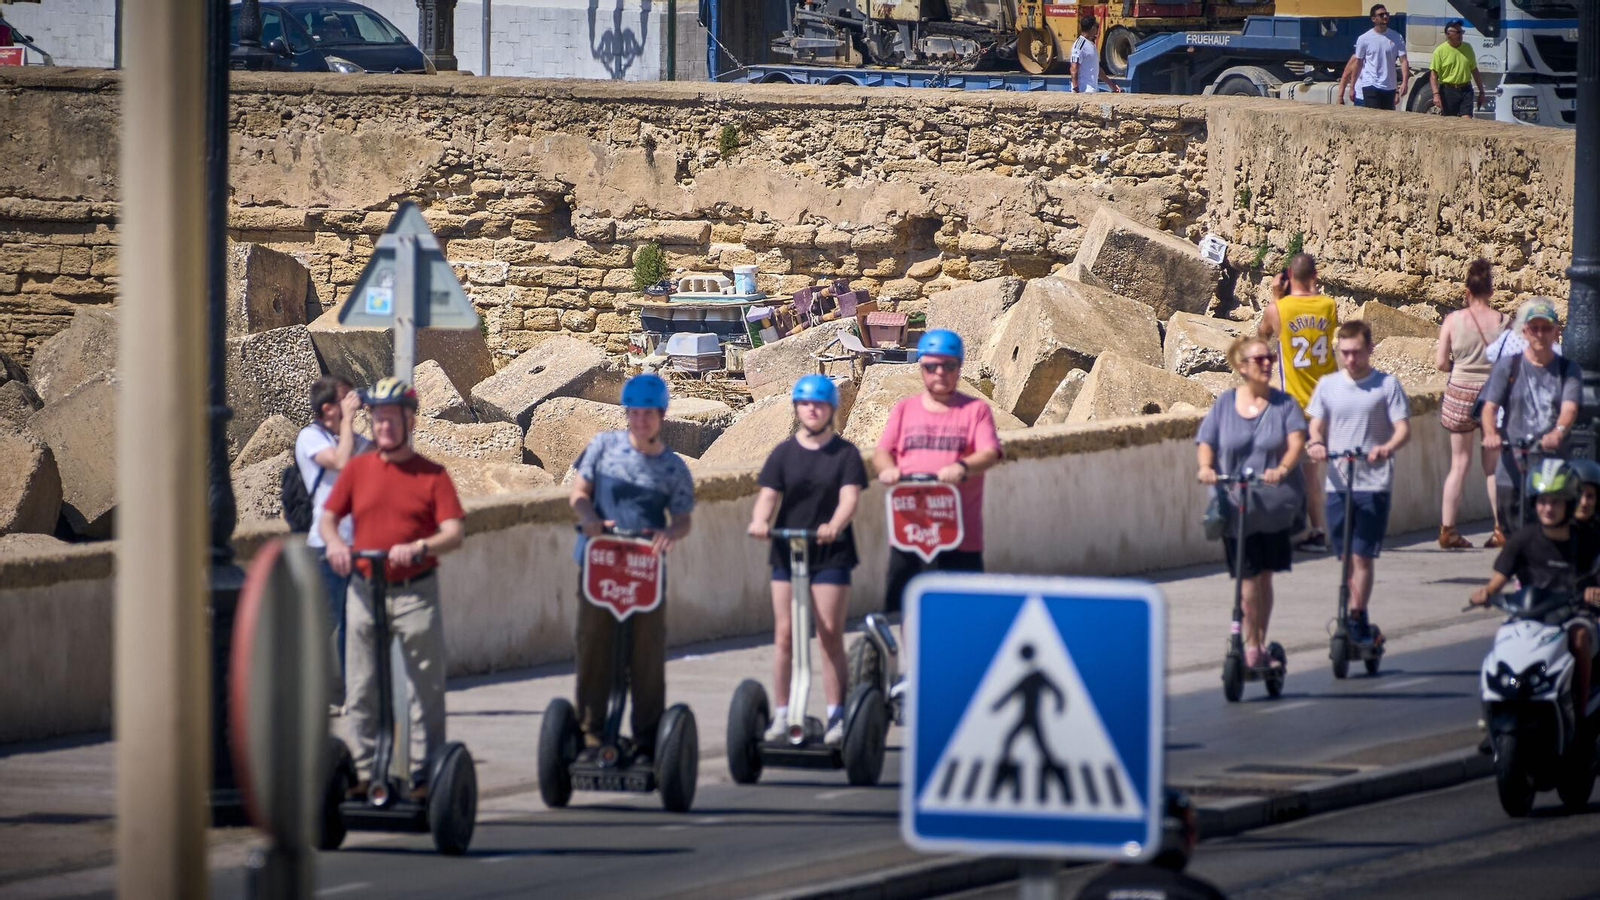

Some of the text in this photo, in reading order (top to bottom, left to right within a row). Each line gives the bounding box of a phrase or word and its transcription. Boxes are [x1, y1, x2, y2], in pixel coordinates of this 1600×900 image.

[1186, 34, 1230, 45] FRUEHAUF
[1291, 335, 1328, 368] 24
[591, 549, 614, 566] SEG
